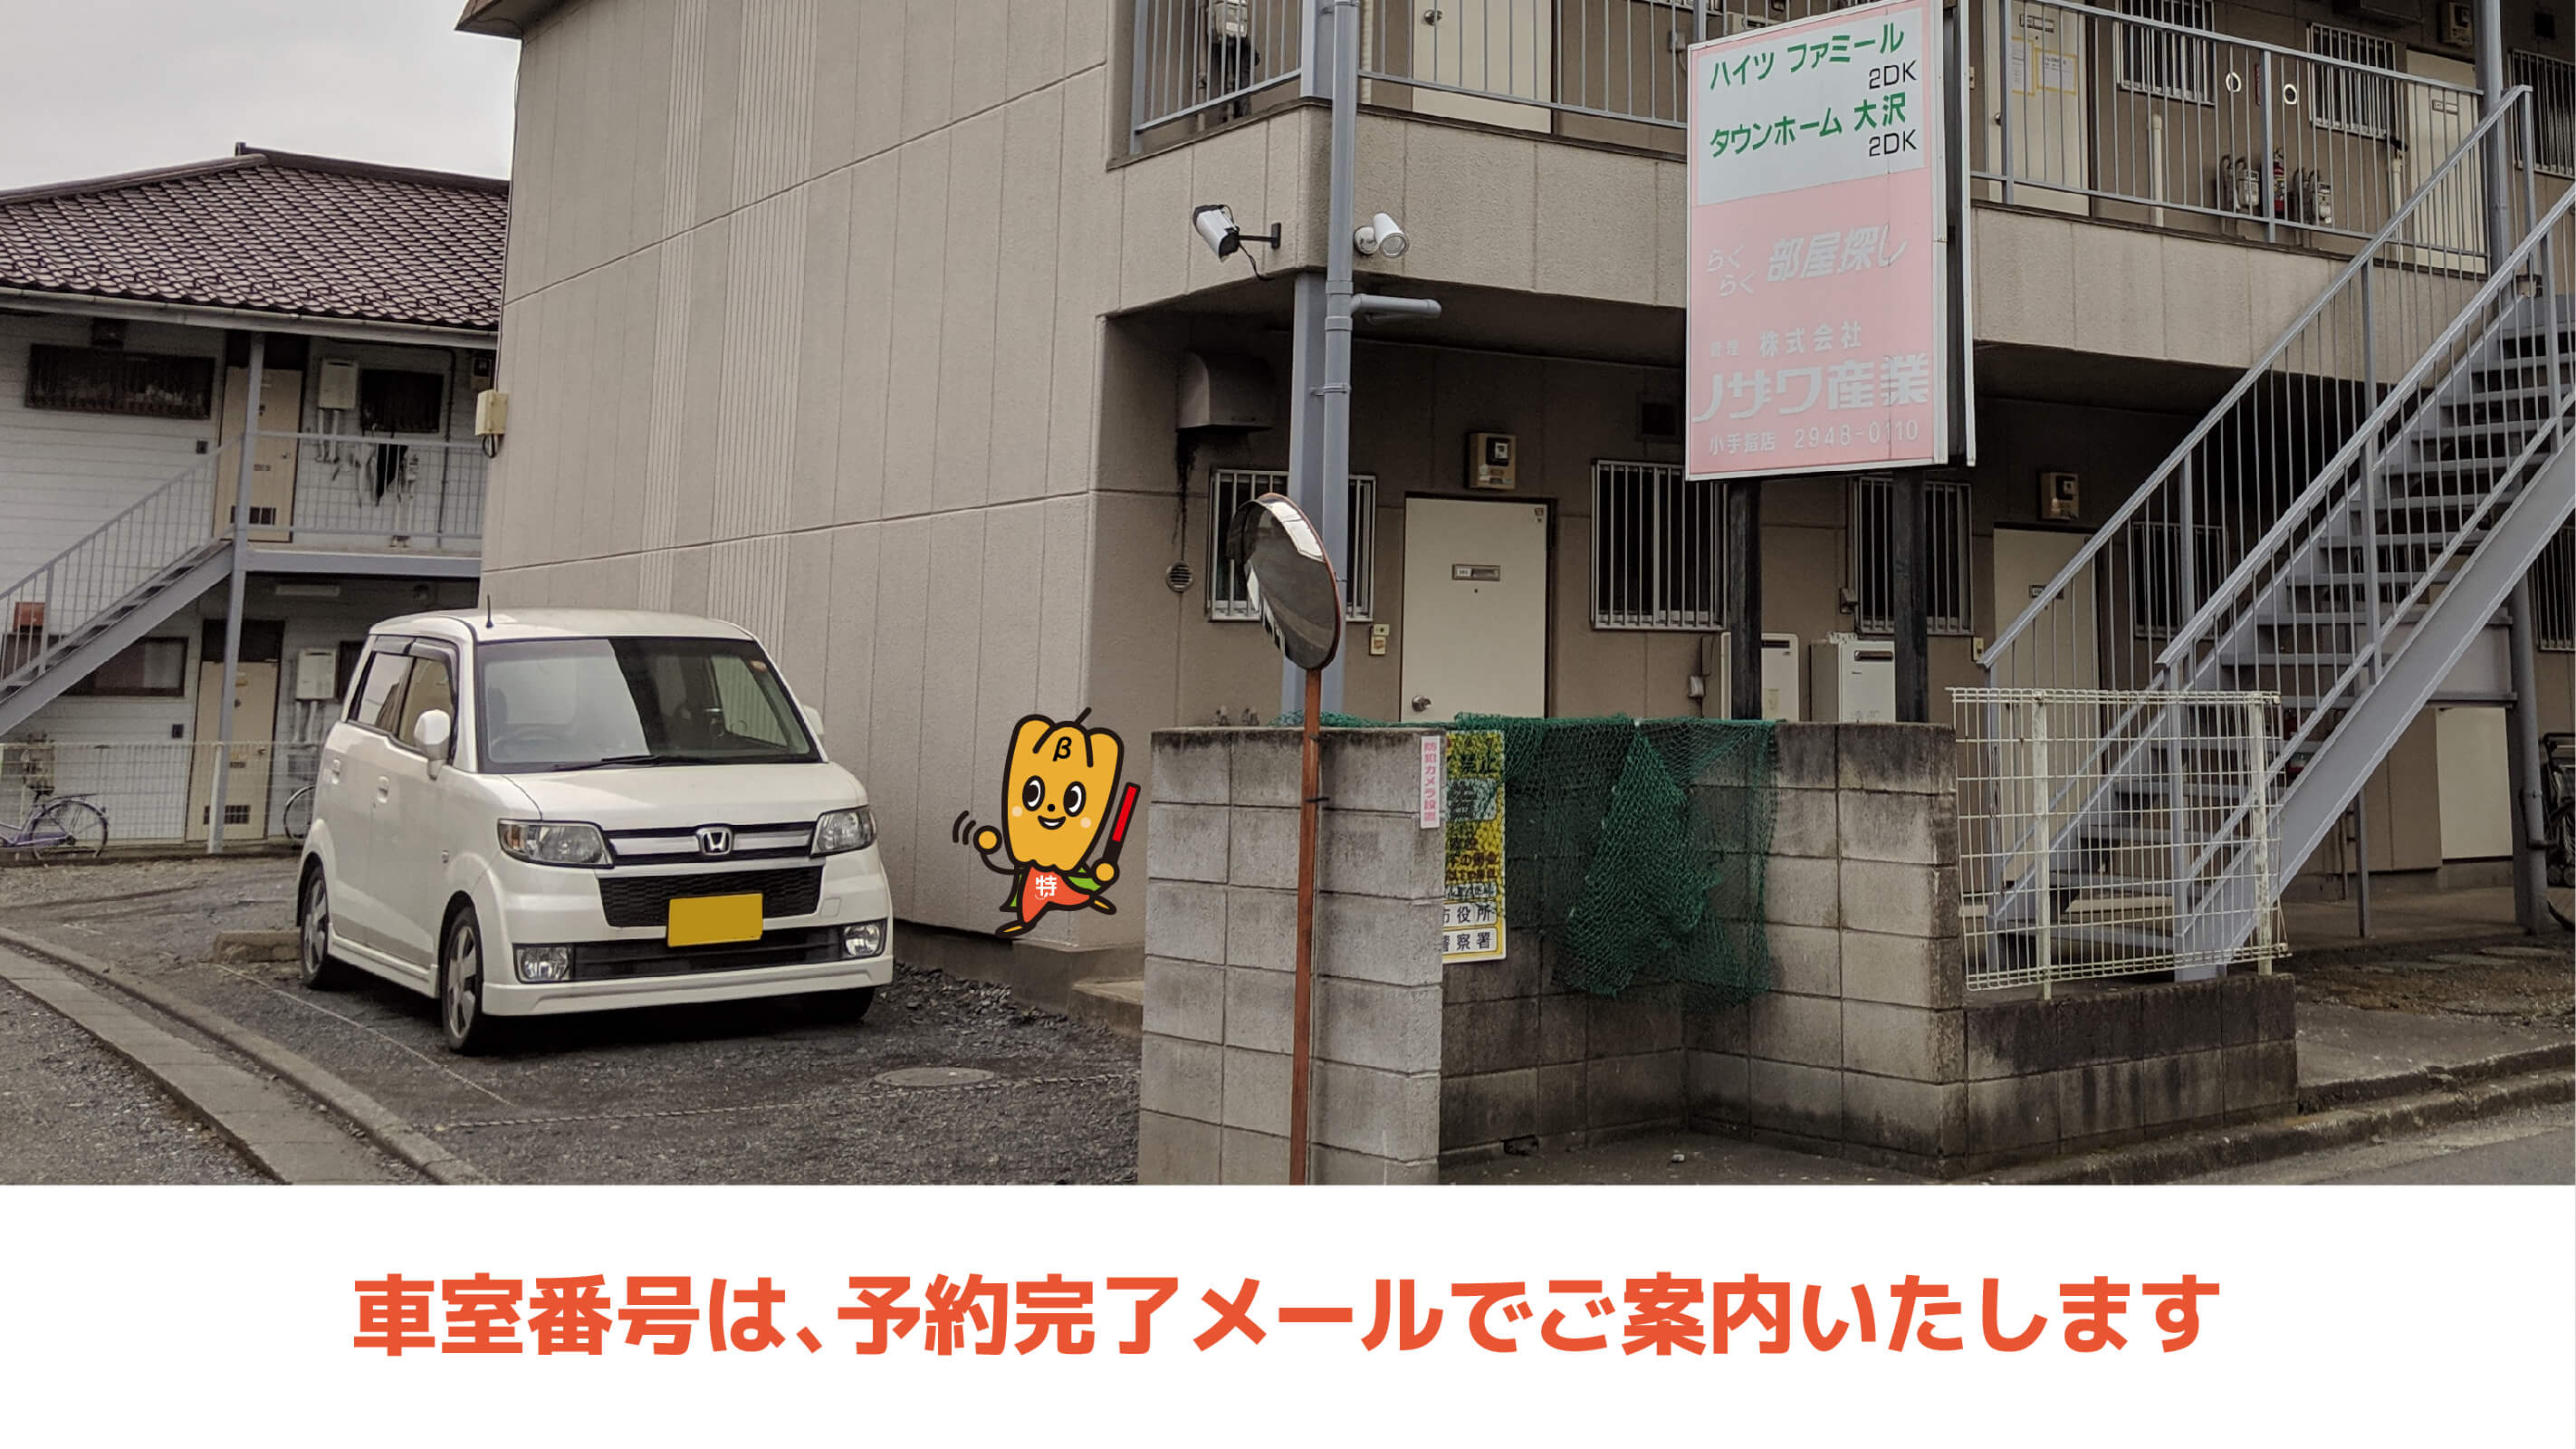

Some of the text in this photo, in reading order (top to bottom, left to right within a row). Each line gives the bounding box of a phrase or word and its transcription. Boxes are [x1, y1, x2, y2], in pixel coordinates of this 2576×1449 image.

[1710, 23, 1904, 90] ハイツ ファミール
[1869, 60, 1917, 90] 2DK
[1710, 91, 1906, 158] タウンホーム 大沢
[1869, 129, 1917, 157] 2DK
[1708, 244, 1744, 273] らく
[1767, 224, 1907, 283] 部屋探し
[1719, 272, 1756, 297] らく
[1760, 321, 1863, 357] 株式会社
[1794, 419, 1920, 449] 2948-0110
